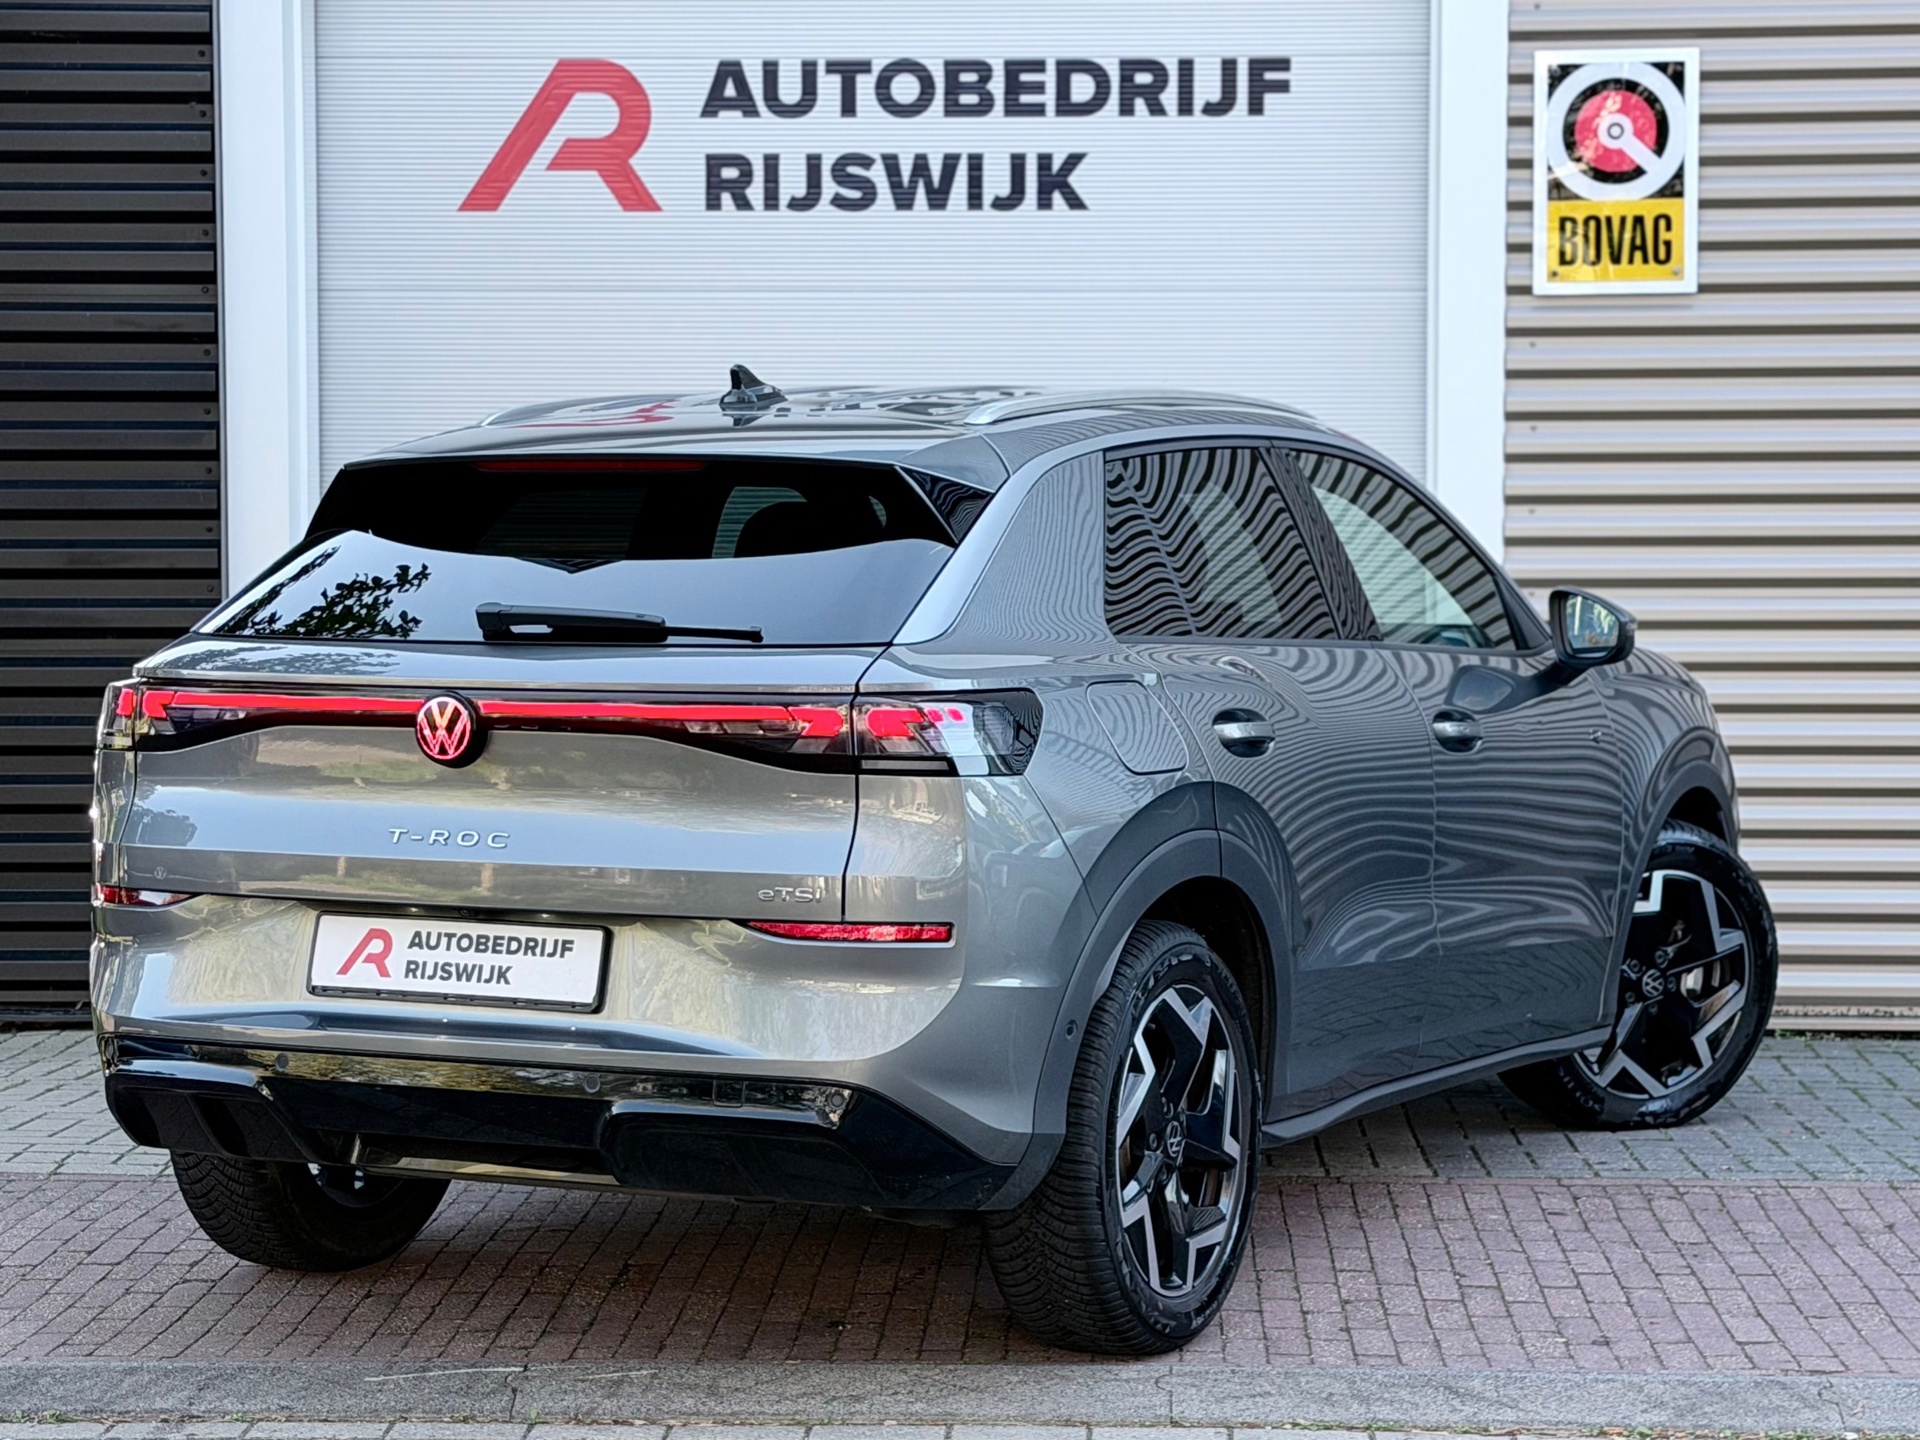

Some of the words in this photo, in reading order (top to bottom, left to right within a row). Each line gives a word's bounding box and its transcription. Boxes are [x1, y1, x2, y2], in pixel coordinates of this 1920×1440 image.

[700, 57, 1292, 119] AUTOBEDRIJF
[704, 152, 1089, 212] RIJSWIJK
[1558, 213, 1672, 266] BOVAG
[388, 827, 511, 849] T-ROC
[407, 930, 575, 959] AUTOBEDRIJF
[404, 960, 513, 986] RIJSWIJK
